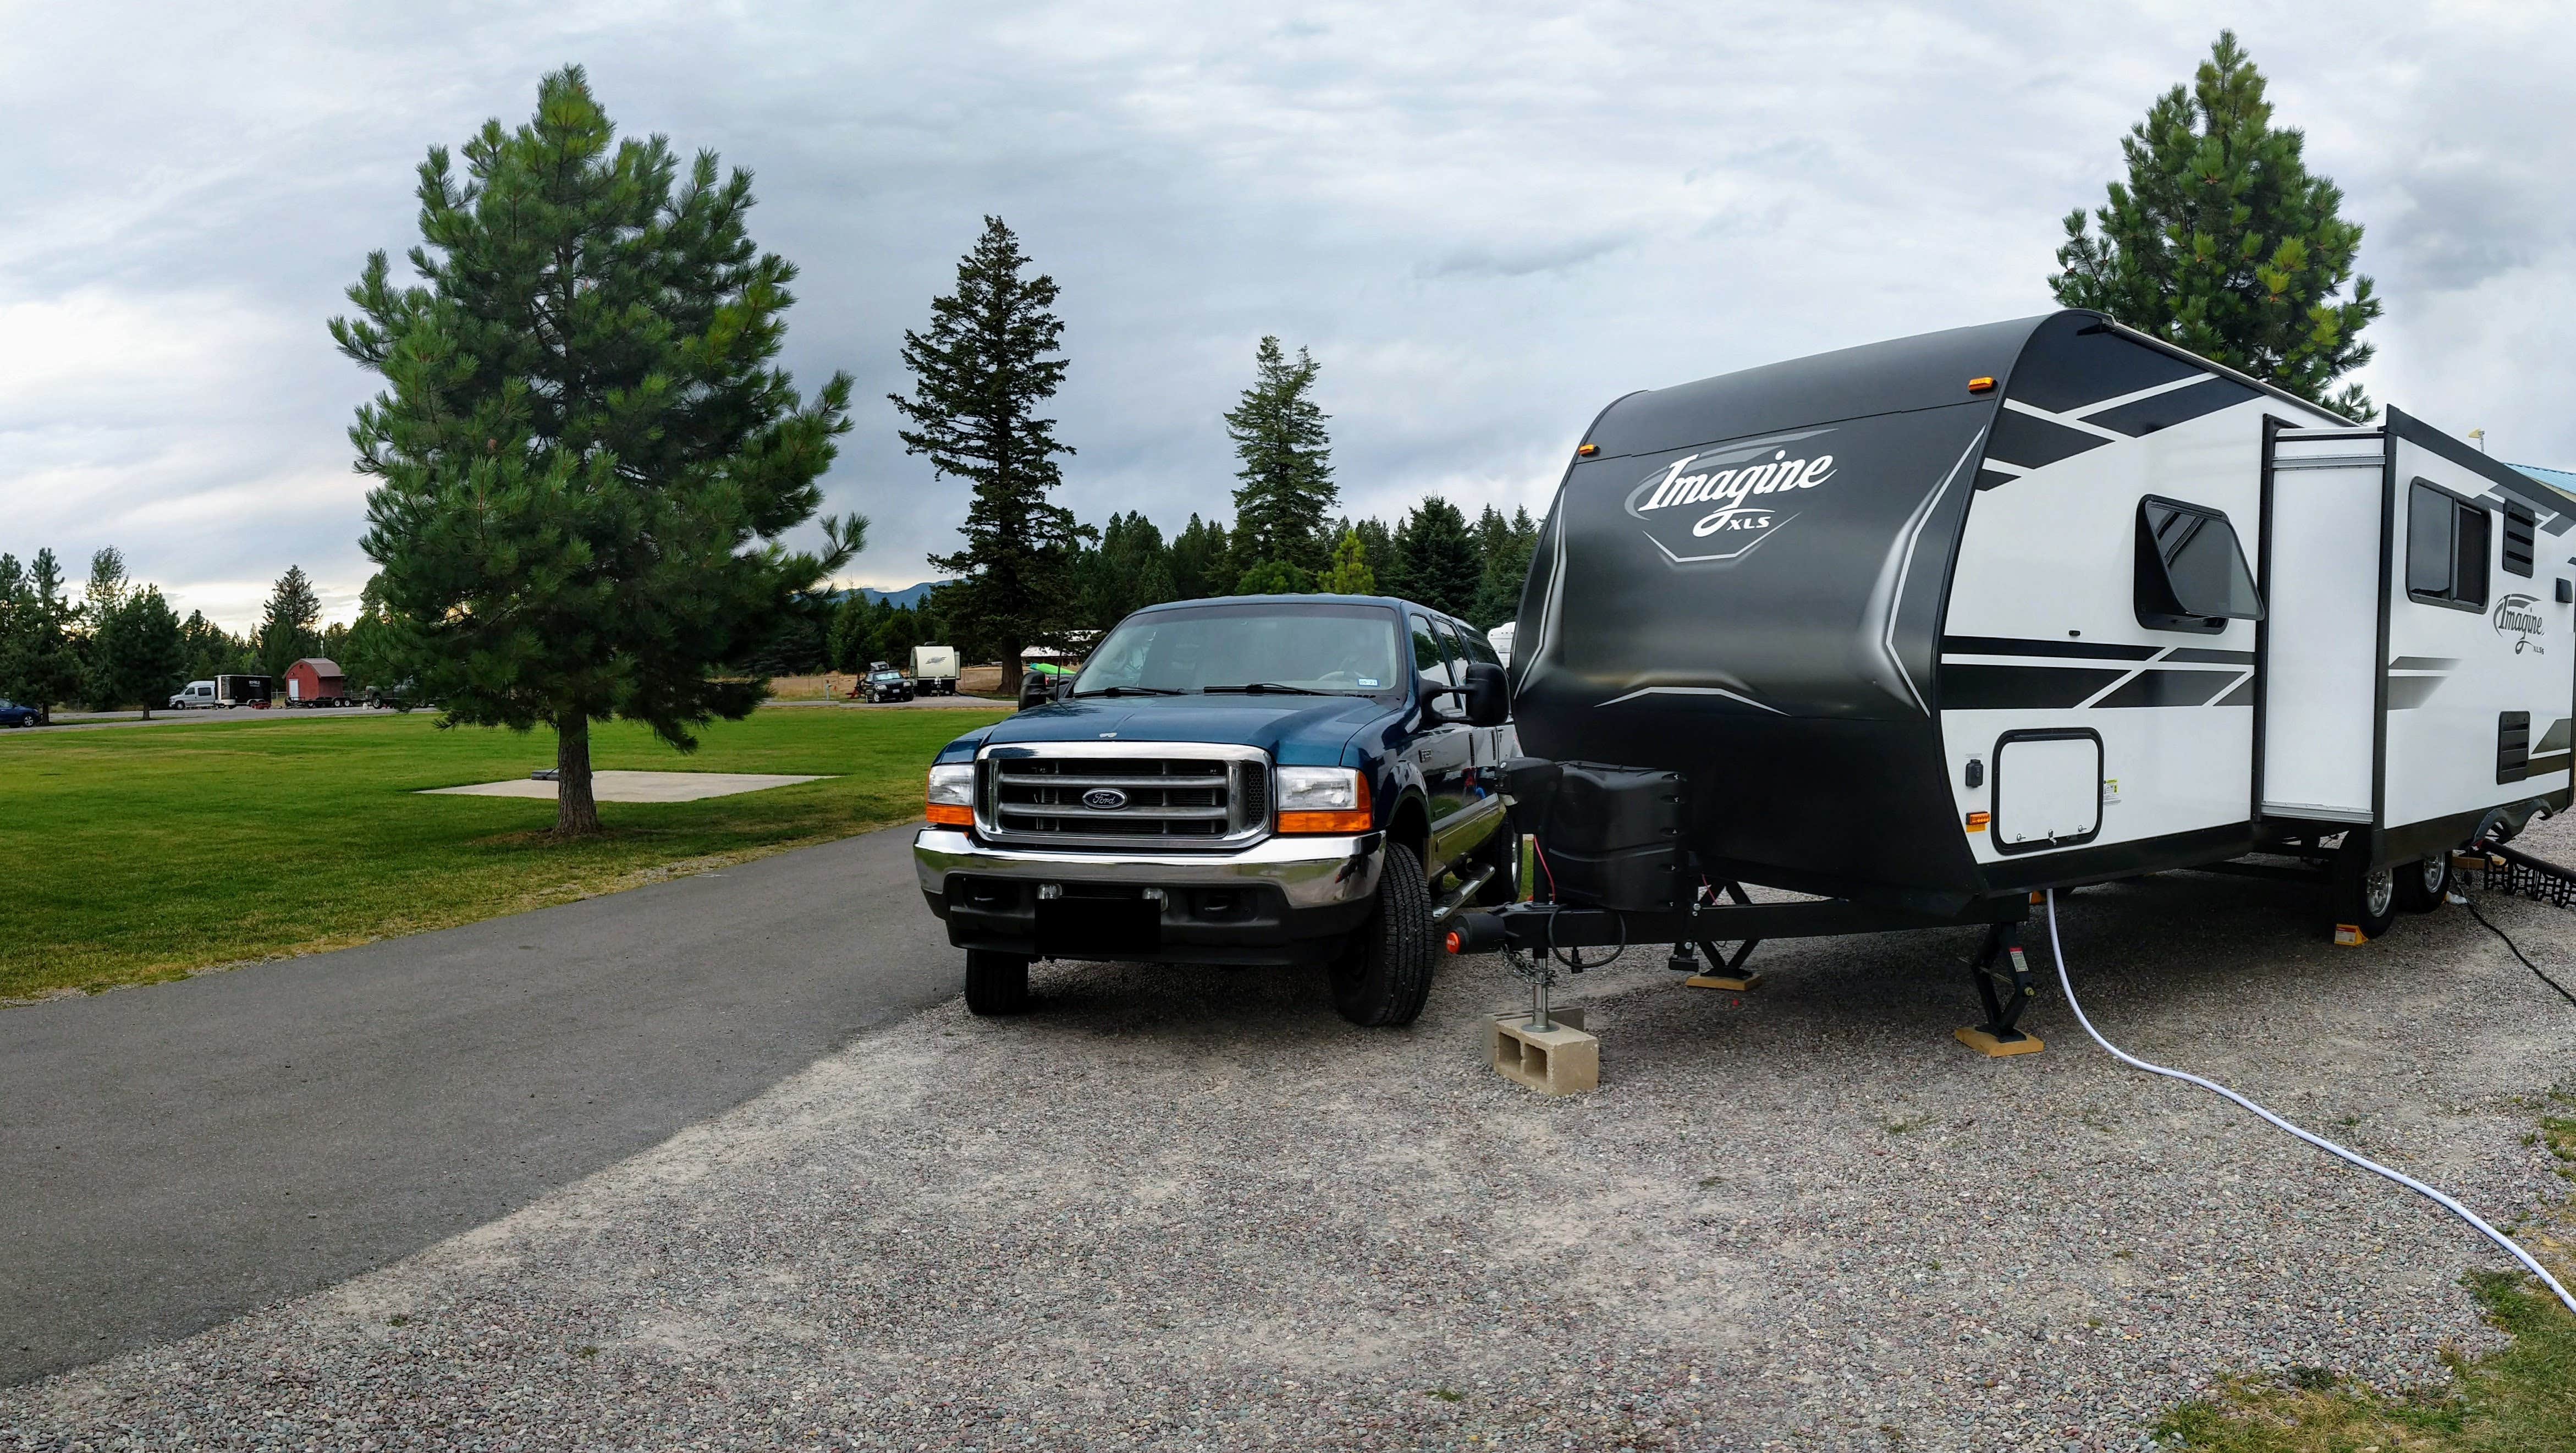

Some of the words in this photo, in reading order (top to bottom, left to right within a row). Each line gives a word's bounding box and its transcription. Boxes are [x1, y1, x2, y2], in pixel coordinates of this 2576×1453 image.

[1638, 449, 1838, 537] Imagine
[1726, 516, 1771, 531] XLS
[2498, 594, 2544, 654] Imagine
[1092, 793, 1116, 804] Ford
